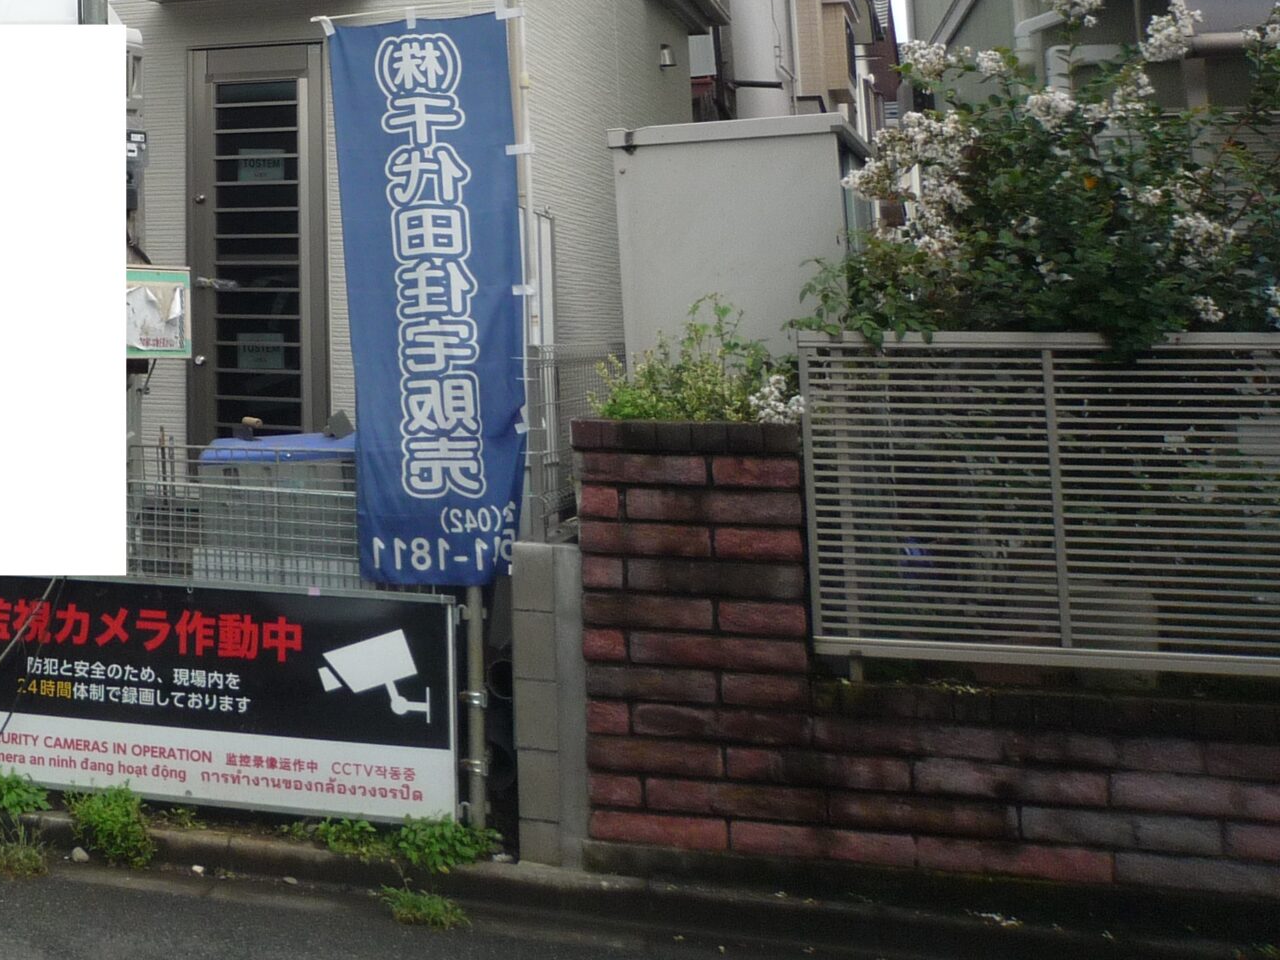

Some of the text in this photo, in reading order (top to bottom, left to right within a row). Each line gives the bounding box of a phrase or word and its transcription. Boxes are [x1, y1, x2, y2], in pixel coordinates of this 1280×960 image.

[242, 158, 281, 168] TOSTEM
[43, 736, 108, 753] CAMERAS
[113, 742, 127, 755] IN
[131, 744, 212, 763] OPERATION
[29, 754, 45, 766] an
[49, 755, 76, 769] ninh
[81, 758, 114, 775] đang
[118, 760, 147, 778] hoạt
[151, 764, 187, 783] động
[225, 752, 318, 773] 监控录像运作中
[331, 761, 416, 782] CCTV작동중
